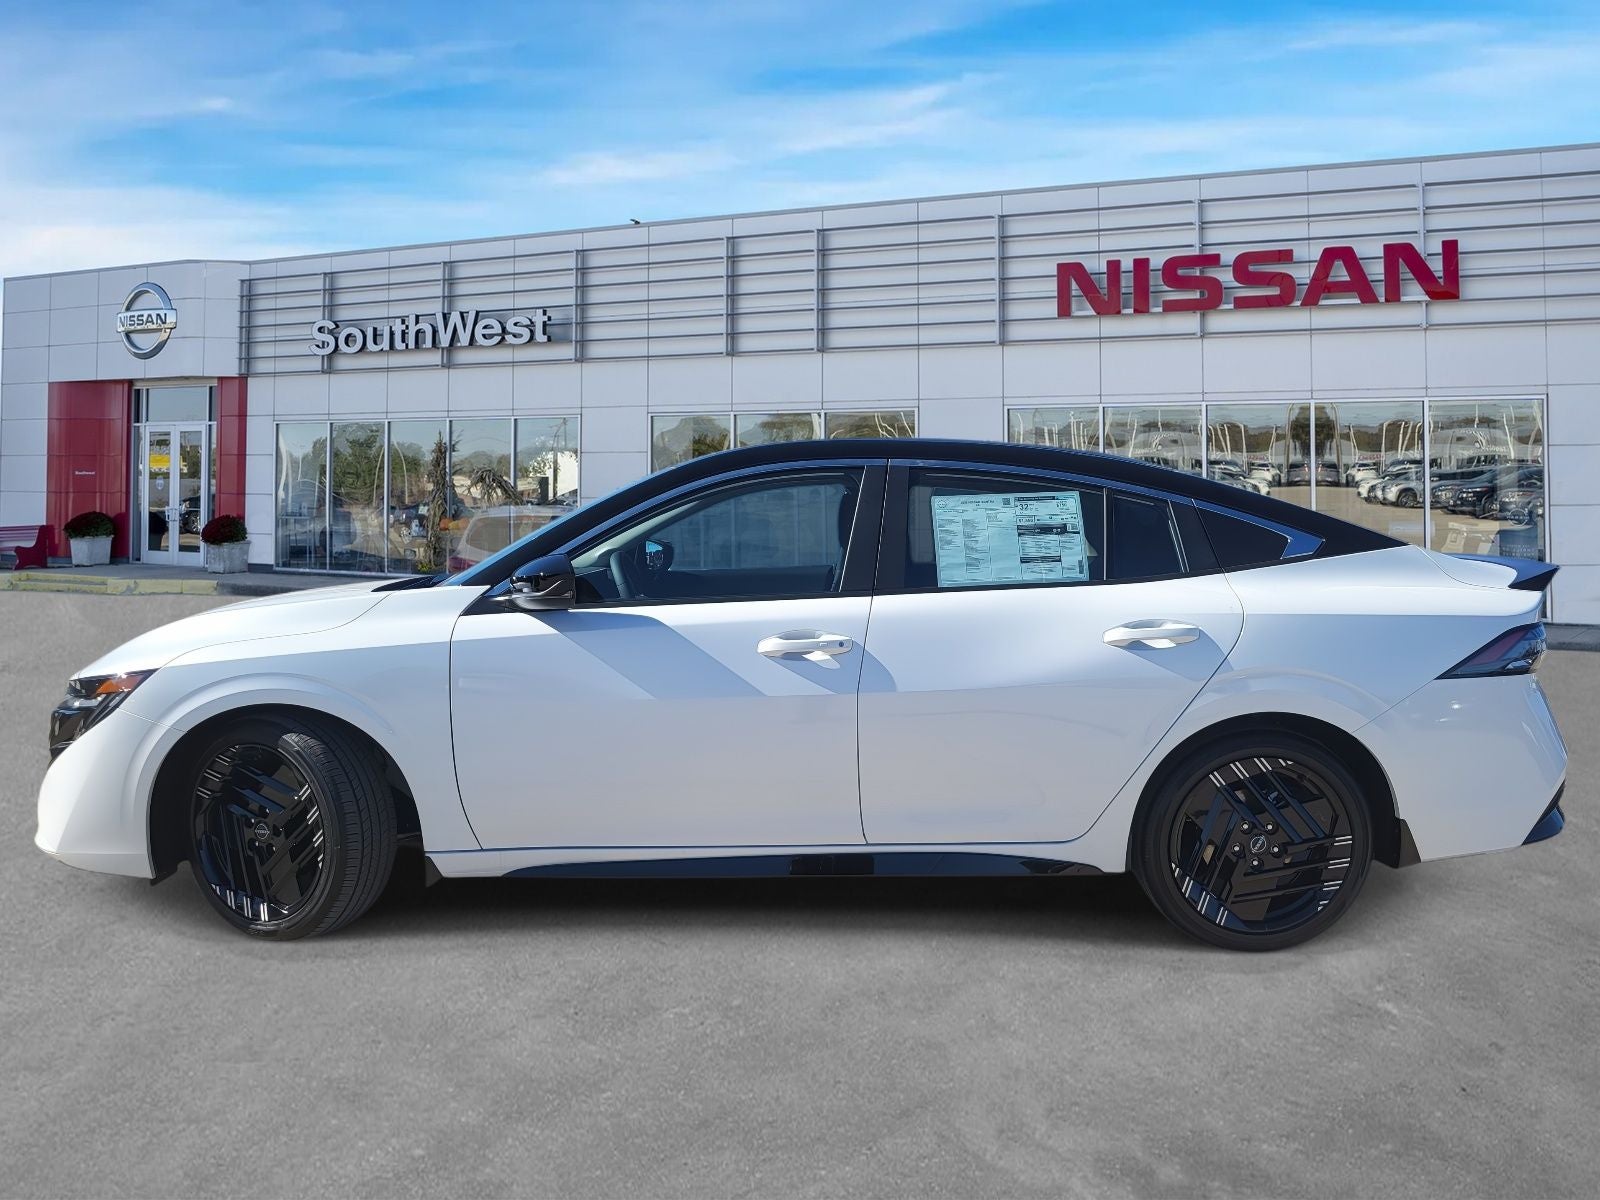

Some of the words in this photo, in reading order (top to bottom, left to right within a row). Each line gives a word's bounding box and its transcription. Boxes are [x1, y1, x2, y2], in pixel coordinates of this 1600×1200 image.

[1056, 239, 1461, 319] NISSAN
[118, 312, 168, 329] NISSAN
[310, 308, 552, 356] SouthWest
